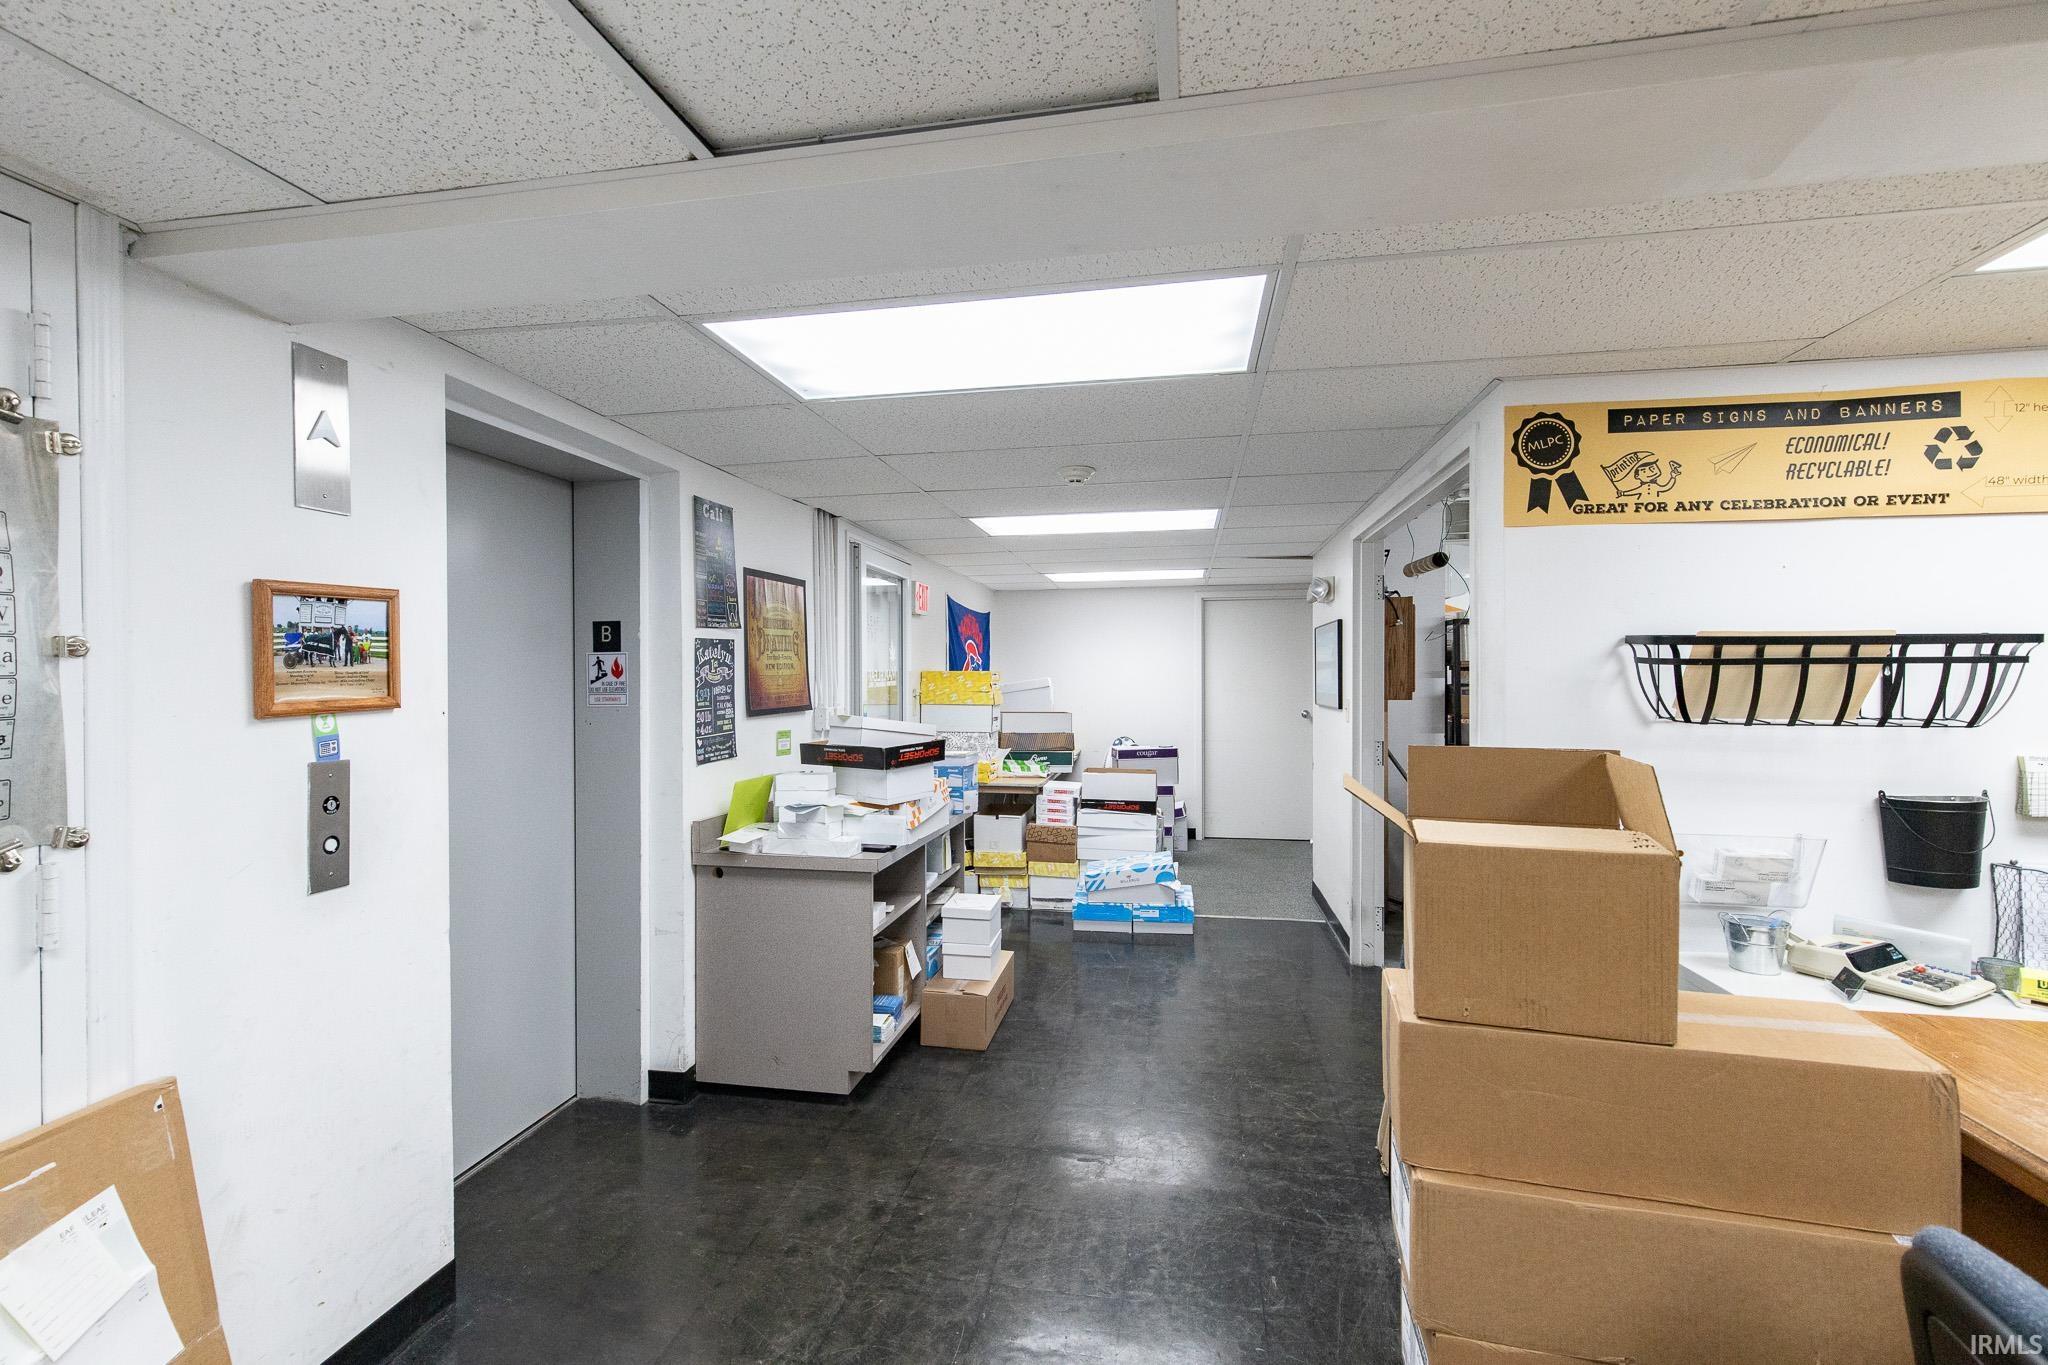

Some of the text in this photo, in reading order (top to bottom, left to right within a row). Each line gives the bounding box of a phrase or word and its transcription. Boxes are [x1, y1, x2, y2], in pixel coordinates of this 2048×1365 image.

[1623, 399, 1944, 427] PAPER SIGNS AND BANNERS
[1527, 434, 1564, 452] MLPC
[1785, 431, 1891, 454] ECONOMICAL!
[1609, 452, 1642, 479] printing
[1785, 458, 1892, 481] RECYCLABLE!
[1987, 474, 2048, 486] 48" width
[702, 503, 723, 523] Cali
[1572, 492, 1950, 515] GREAT FOR ANY CELEBRATION OR EVENT
[601, 625, 612, 643] B
[824, 752, 864, 763] SOPORSET
[899, 747, 940, 762] SOPORSET
[1136, 749, 1158, 759] cougar
